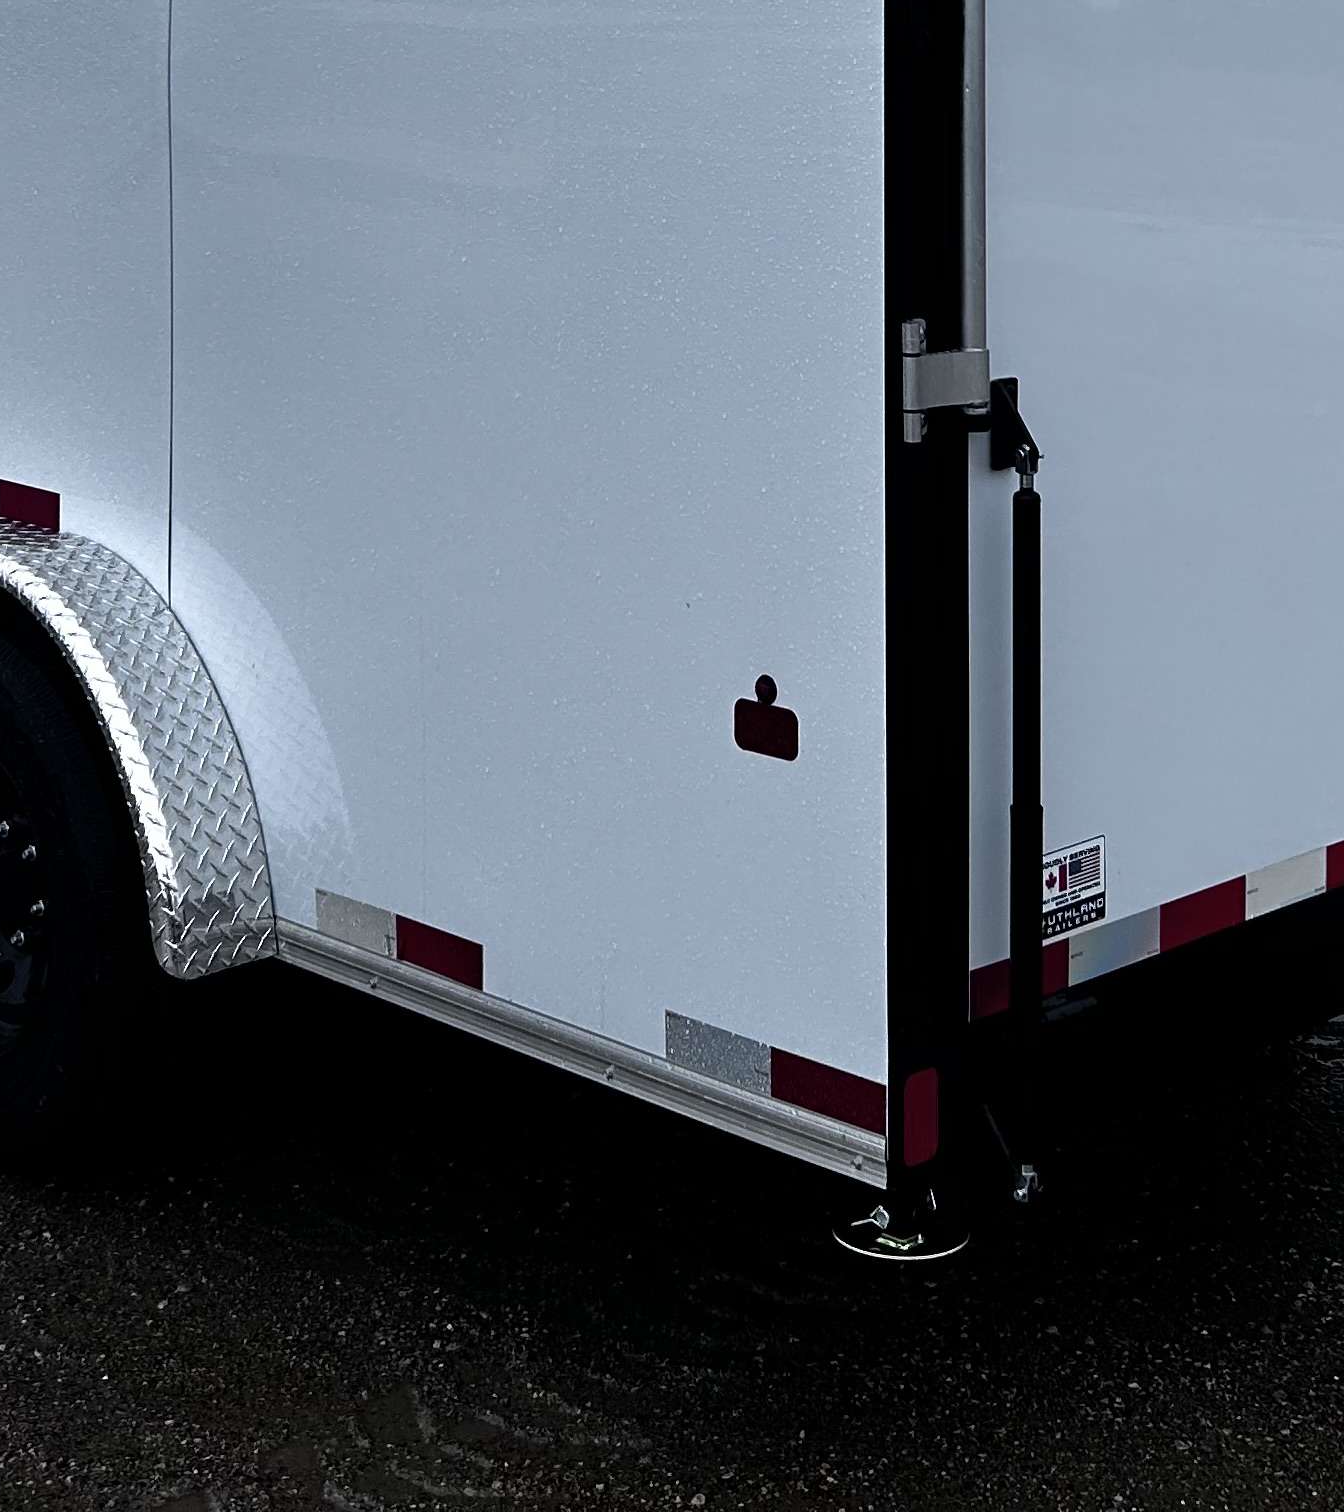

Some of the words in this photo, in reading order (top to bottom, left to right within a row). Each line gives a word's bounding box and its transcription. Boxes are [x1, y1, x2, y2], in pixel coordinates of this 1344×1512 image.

[1043, 854, 1068, 870] OUDLY
[1043, 897, 1104, 928] UTHLAND
[1047, 911, 1097, 935] RAILERS
